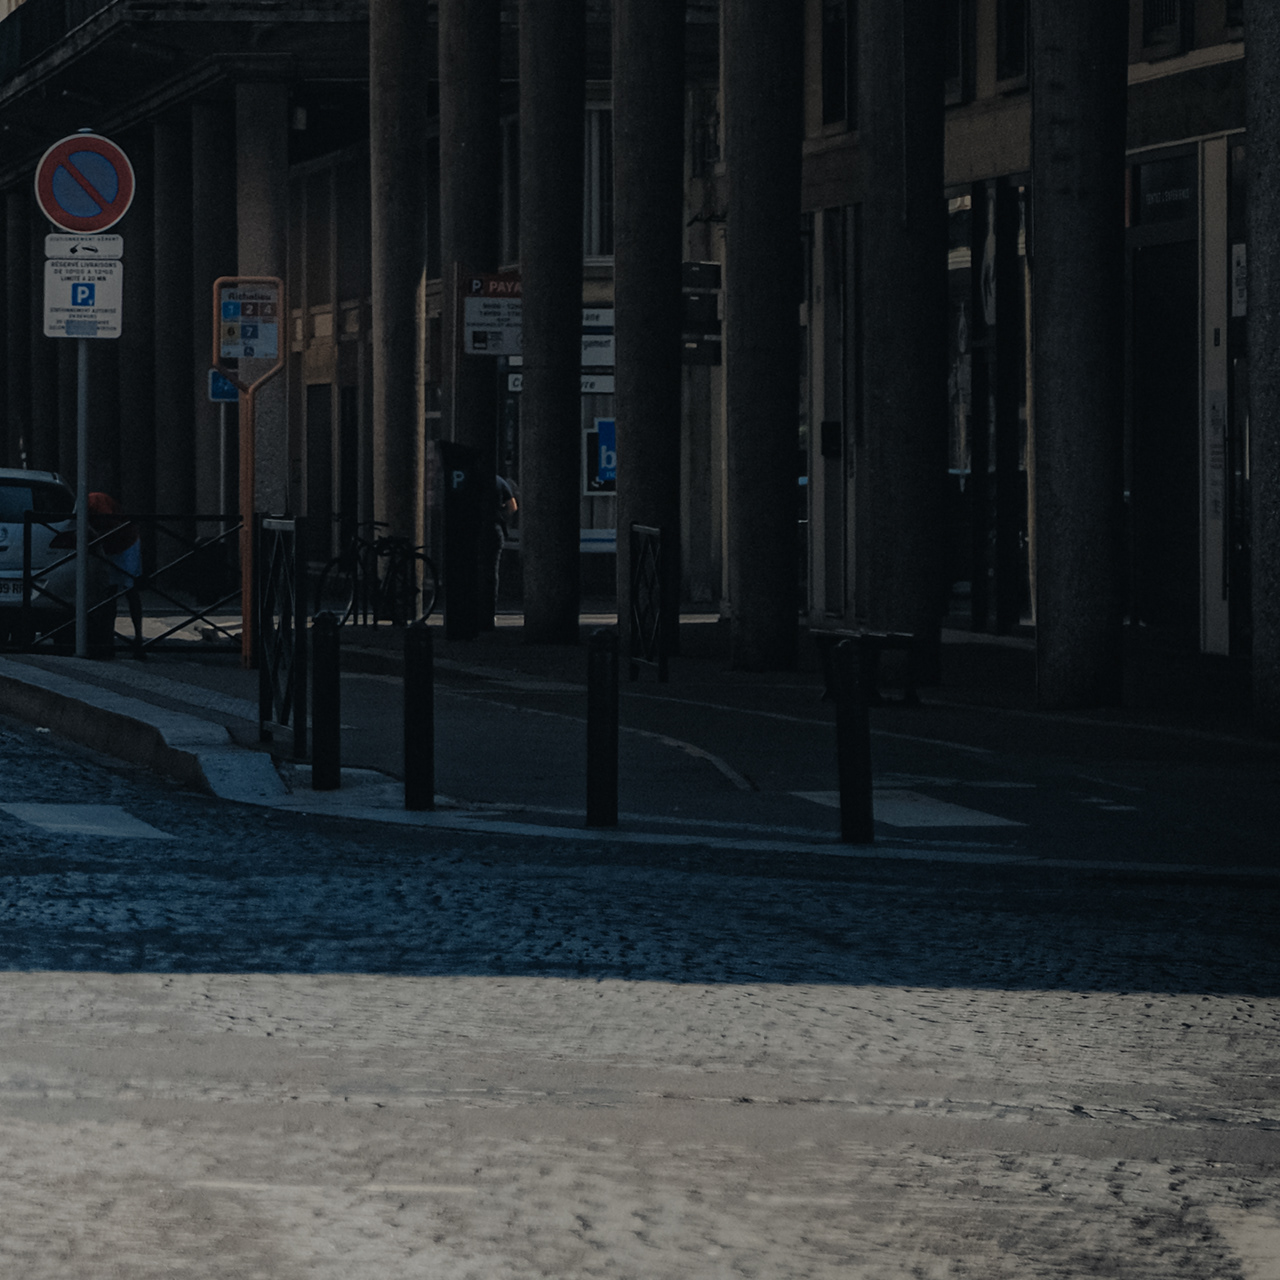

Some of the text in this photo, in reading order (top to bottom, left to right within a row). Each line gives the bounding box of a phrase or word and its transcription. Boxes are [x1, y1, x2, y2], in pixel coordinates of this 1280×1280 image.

[472, 279, 482, 293] P
[77, 285, 90, 303] P
[246, 304, 254, 315] 2
[263, 304, 272, 314] 4
[227, 327, 253, 337] 6 7
[452, 471, 465, 489] P
